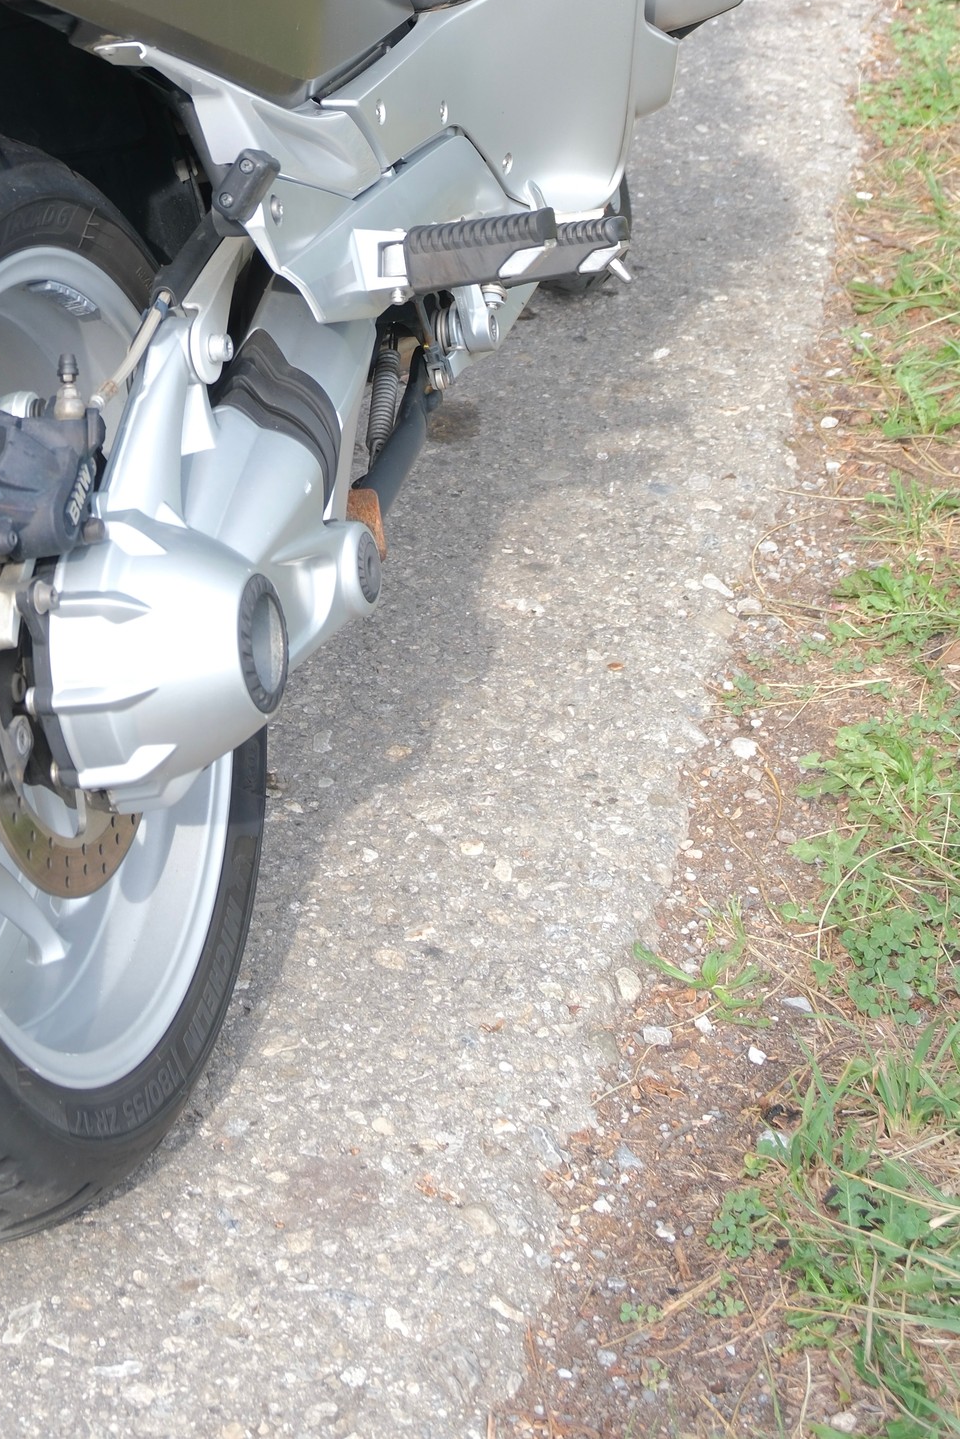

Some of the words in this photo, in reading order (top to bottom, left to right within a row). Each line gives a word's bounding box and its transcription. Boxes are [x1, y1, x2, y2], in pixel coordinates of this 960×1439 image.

[66, 463, 92, 527] BMW
[182, 893, 243, 1062] MICHELIN
[122, 1059, 180, 1128] 180/55
